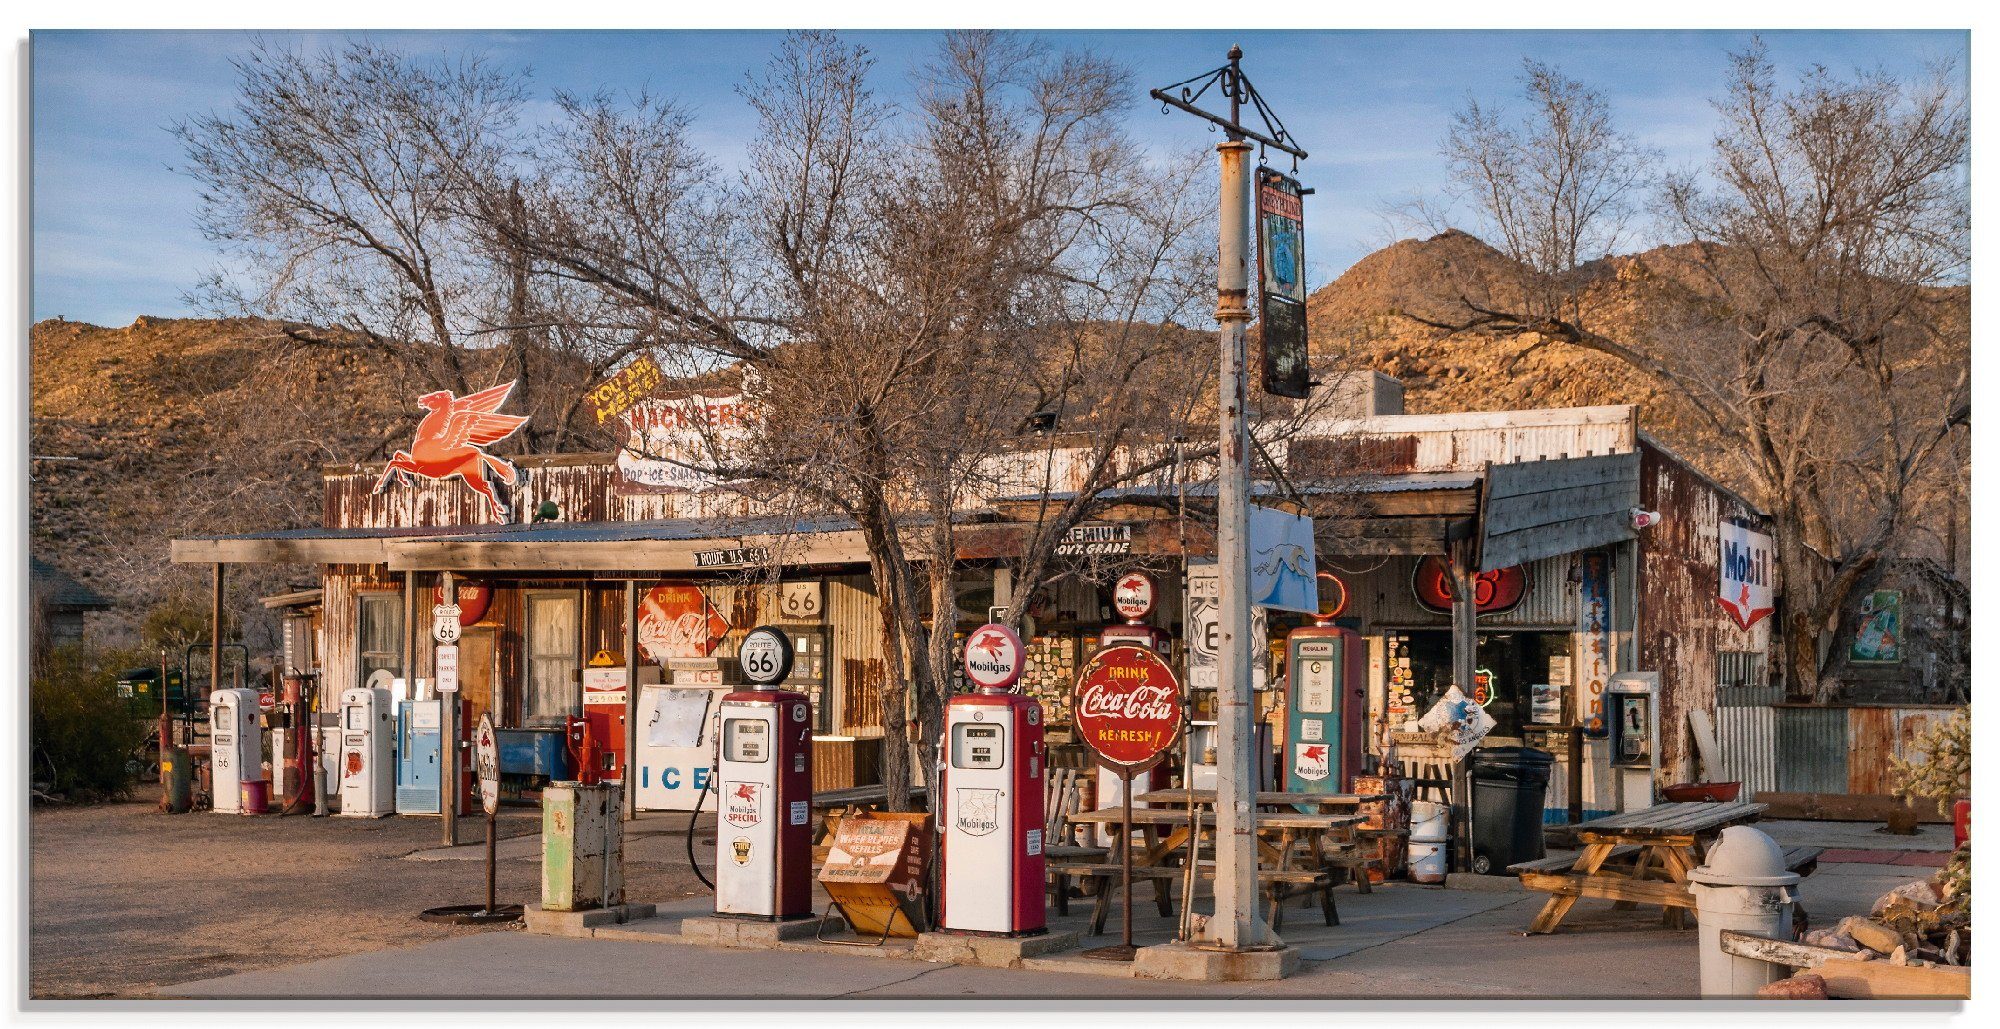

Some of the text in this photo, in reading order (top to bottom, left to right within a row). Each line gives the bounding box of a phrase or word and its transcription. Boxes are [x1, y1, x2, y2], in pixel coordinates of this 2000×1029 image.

[588, 356, 652, 406] YOU ARE
[631, 404, 762, 432] HACKBERR
[624, 468, 642, 481] POP
[649, 467, 663, 480] ICE
[1061, 527, 1124, 543] REMIUM
[1086, 543, 1130, 554] GRADE
[700, 552, 726, 565] ROUTE
[729, 550, 746, 563] U.S.
[1724, 539, 1768, 587] Mobil
[658, 593, 691, 603] DRINK
[788, 592, 815, 611] 66
[1117, 597, 1148, 606] Mobilgas
[1121, 605, 1143, 613] SPECIAL
[440, 625, 454, 639] 66
[1589, 556, 1604, 734] Firestone
[749, 651, 773, 673] 66
[969, 661, 1011, 675] Mobilgas
[694, 671, 719, 683] ICE
[1109, 667, 1149, 679] DRINK
[1080, 684, 1175, 720] Coca-Cola
[218, 757, 229, 768] 66
[642, 766, 712, 790] ICE
[1297, 766, 1328, 776] Mobilgas
[730, 804, 757, 815] Mobilgas
[728, 813, 758, 823] SPECIAL
[959, 818, 995, 831] Mobilgas
[828, 869, 859, 877] WASHER
